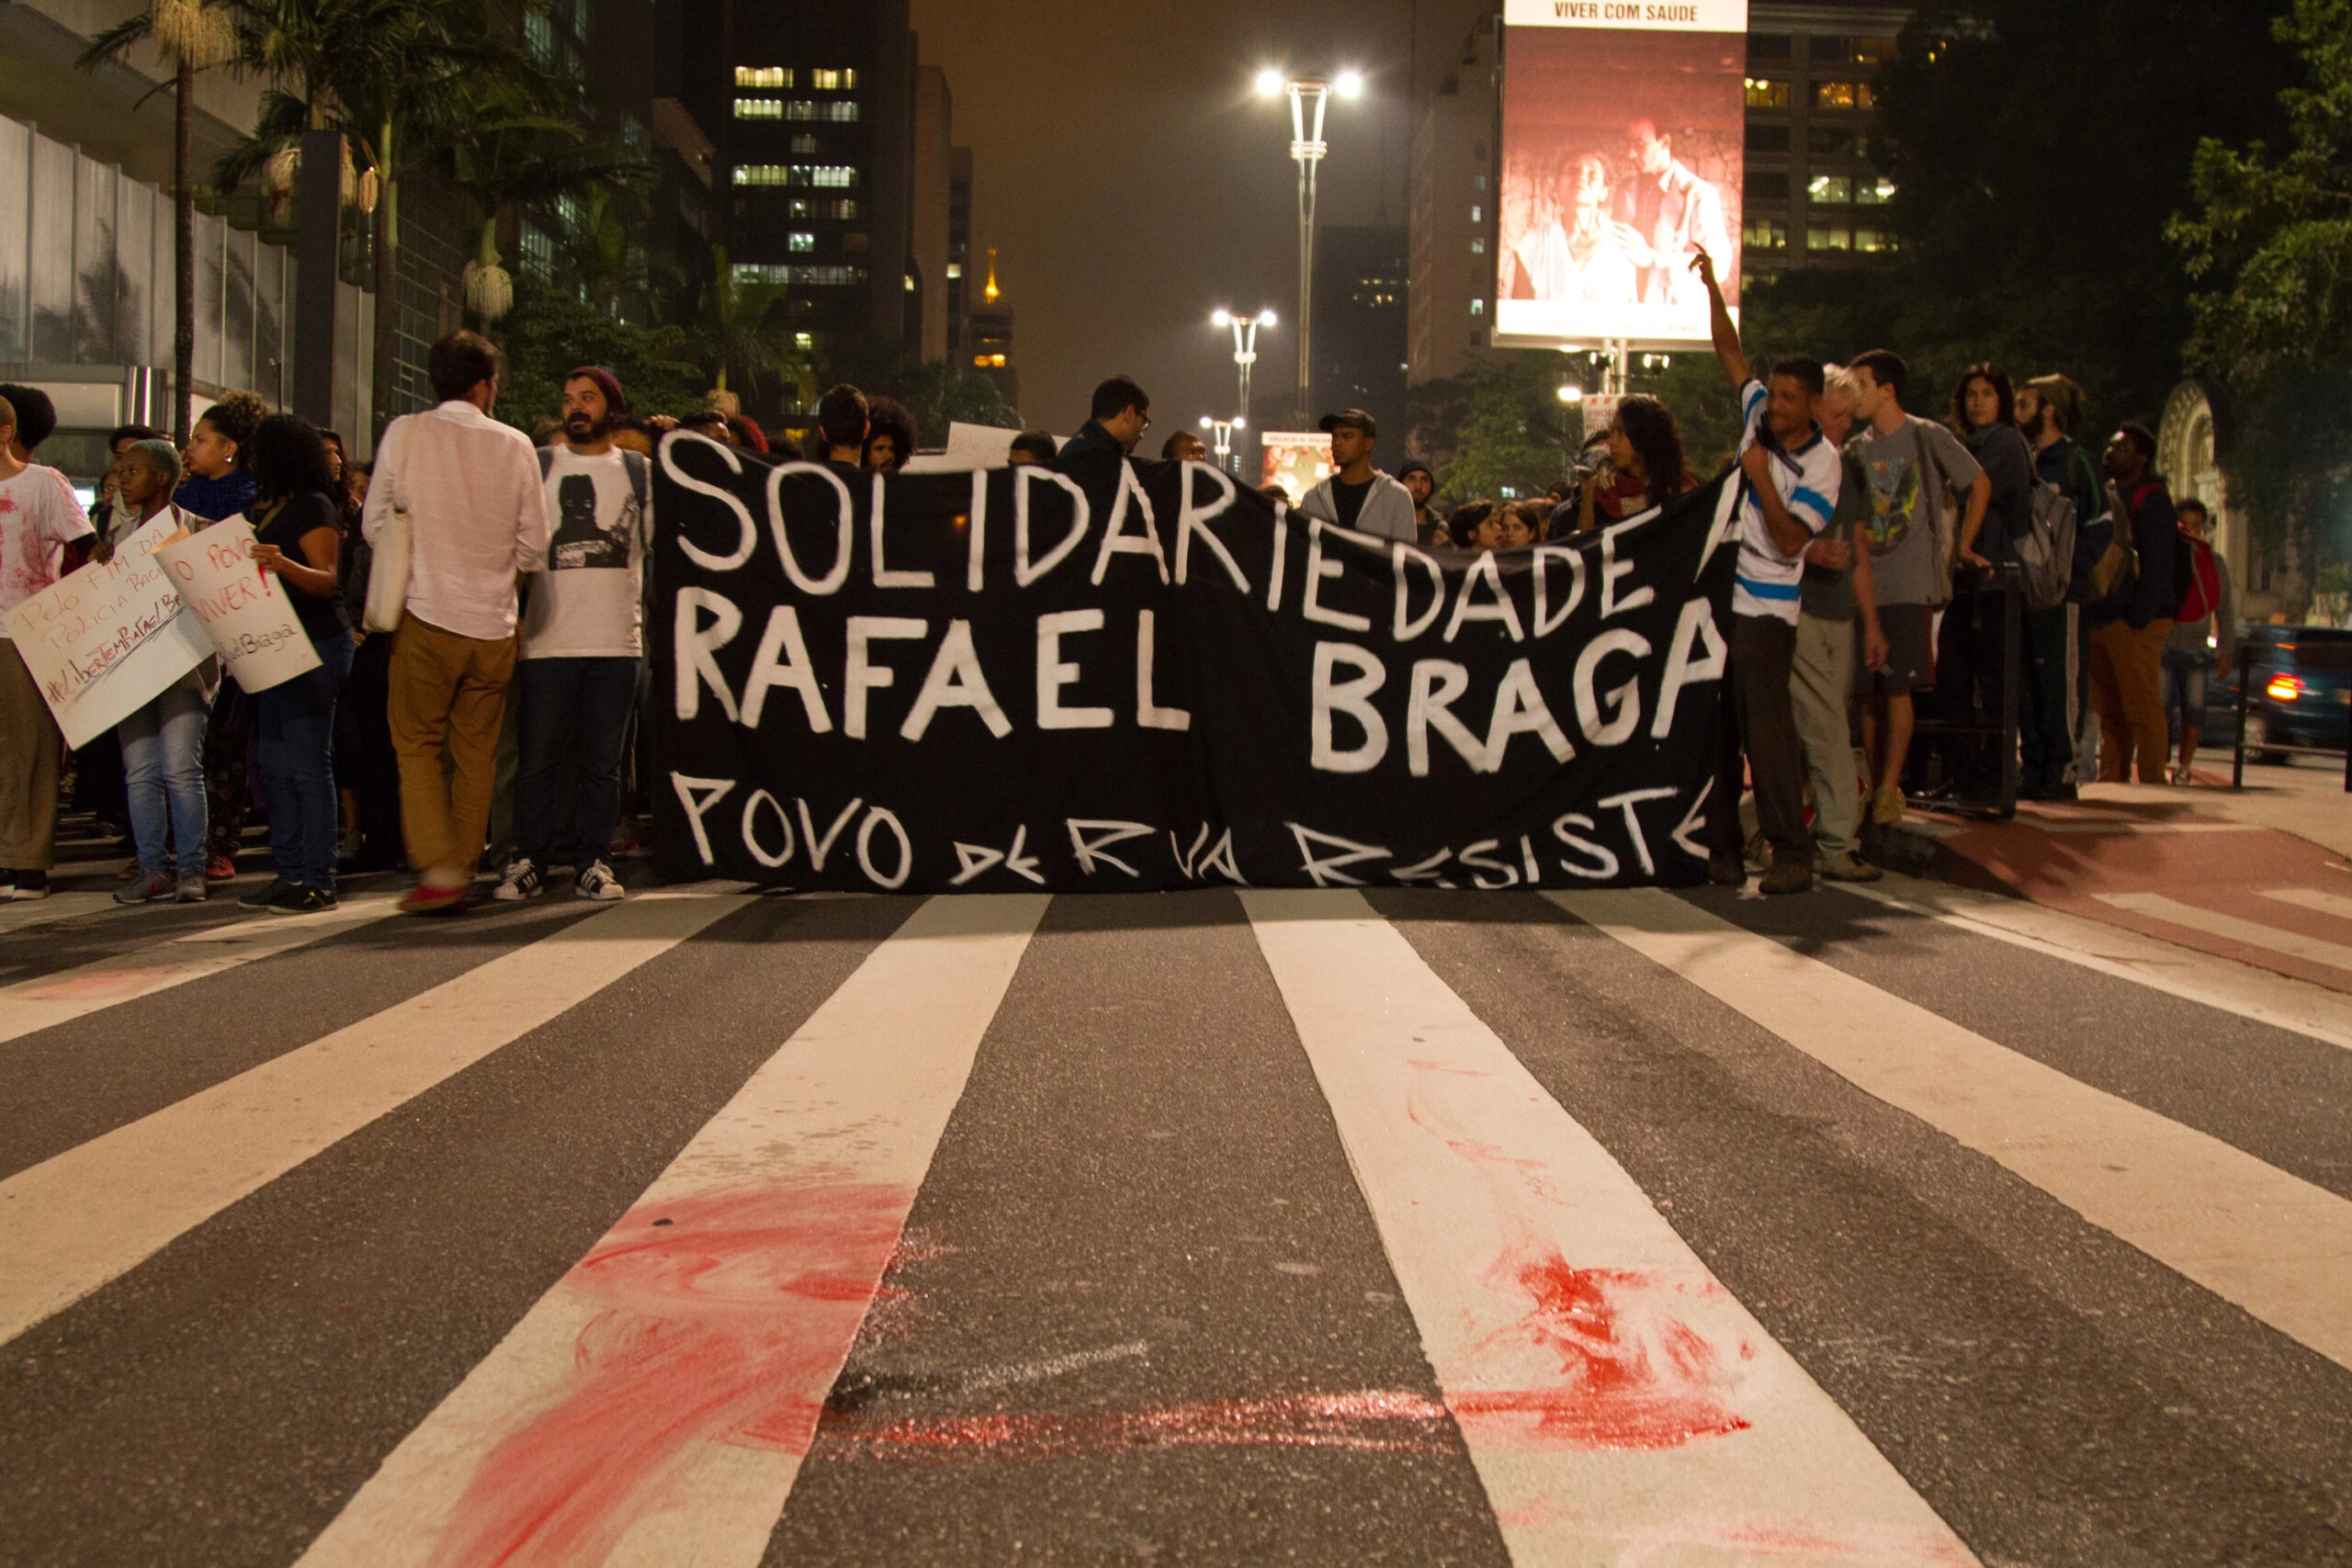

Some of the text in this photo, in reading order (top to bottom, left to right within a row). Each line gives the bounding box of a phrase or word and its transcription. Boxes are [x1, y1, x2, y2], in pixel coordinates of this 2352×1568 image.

[1555, 1, 1598, 18] VIVER
[1604, 4, 1640, 20] COM
[86, 555, 130, 590] FIM
[135, 528, 164, 556] DA
[175, 536, 259, 581] O POVO
[660, 429, 1661, 643] SOLIDARIEDADE
[126, 568, 163, 592] RACI
[674, 586, 1727, 776] RAFAEL BRAGA
[669, 772, 912, 889] POVO
[949, 825, 1046, 886] DE
[1284, 774, 1710, 889] RESISTE
